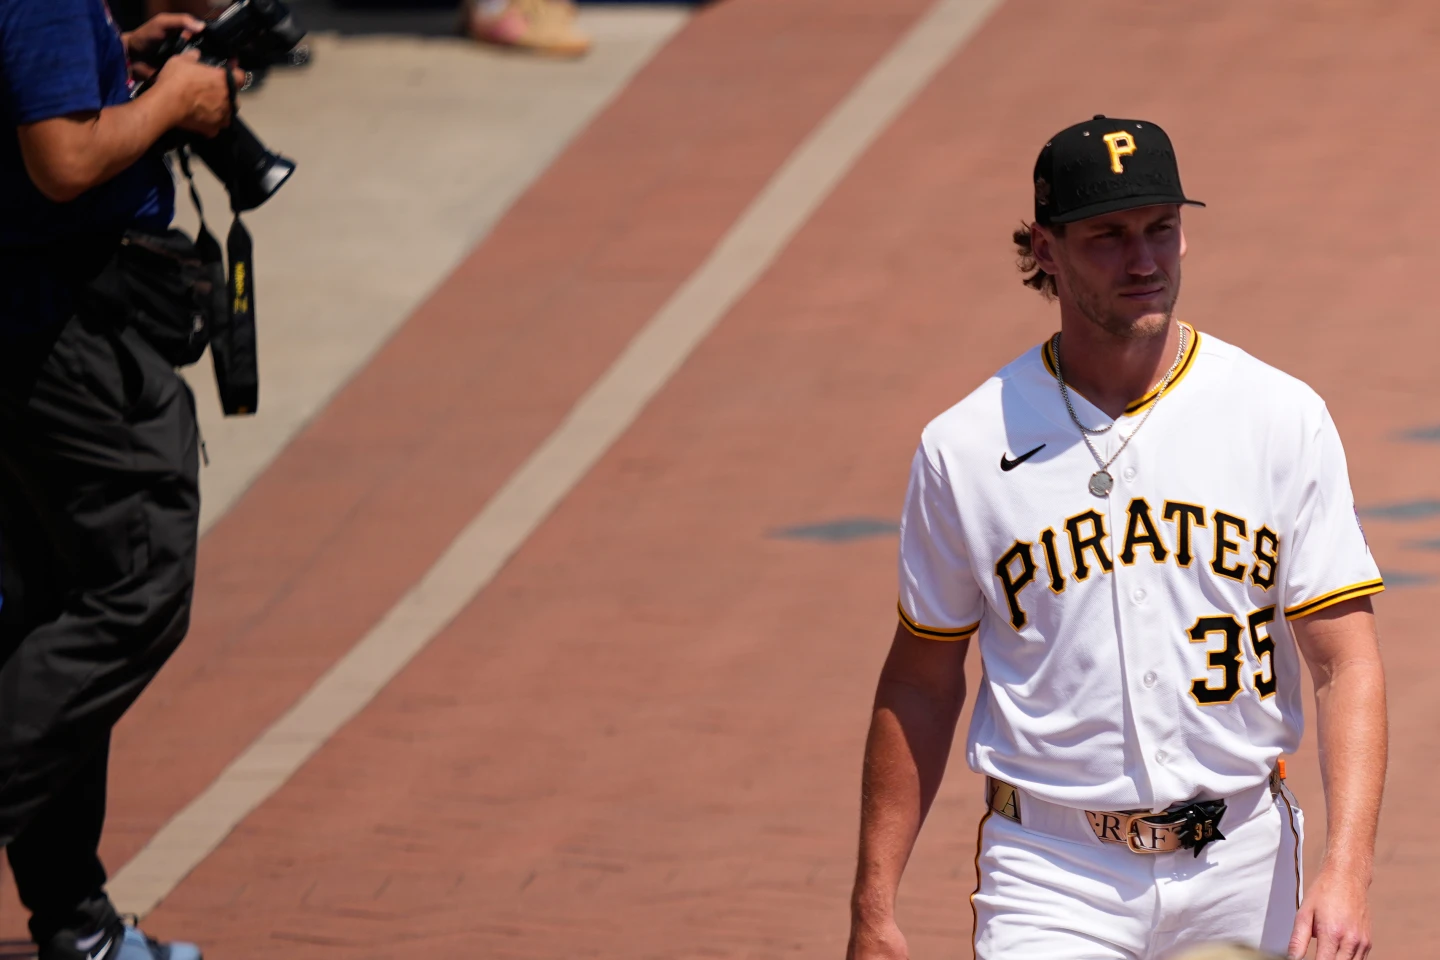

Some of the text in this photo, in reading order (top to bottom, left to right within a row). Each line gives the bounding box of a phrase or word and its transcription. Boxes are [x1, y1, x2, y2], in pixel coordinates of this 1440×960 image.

[1102, 129, 1137, 174] P
[995, 497, 1279, 632] PIRATES
[1186, 604, 1277, 706] 35
[1193, 819, 1213, 841] 35
